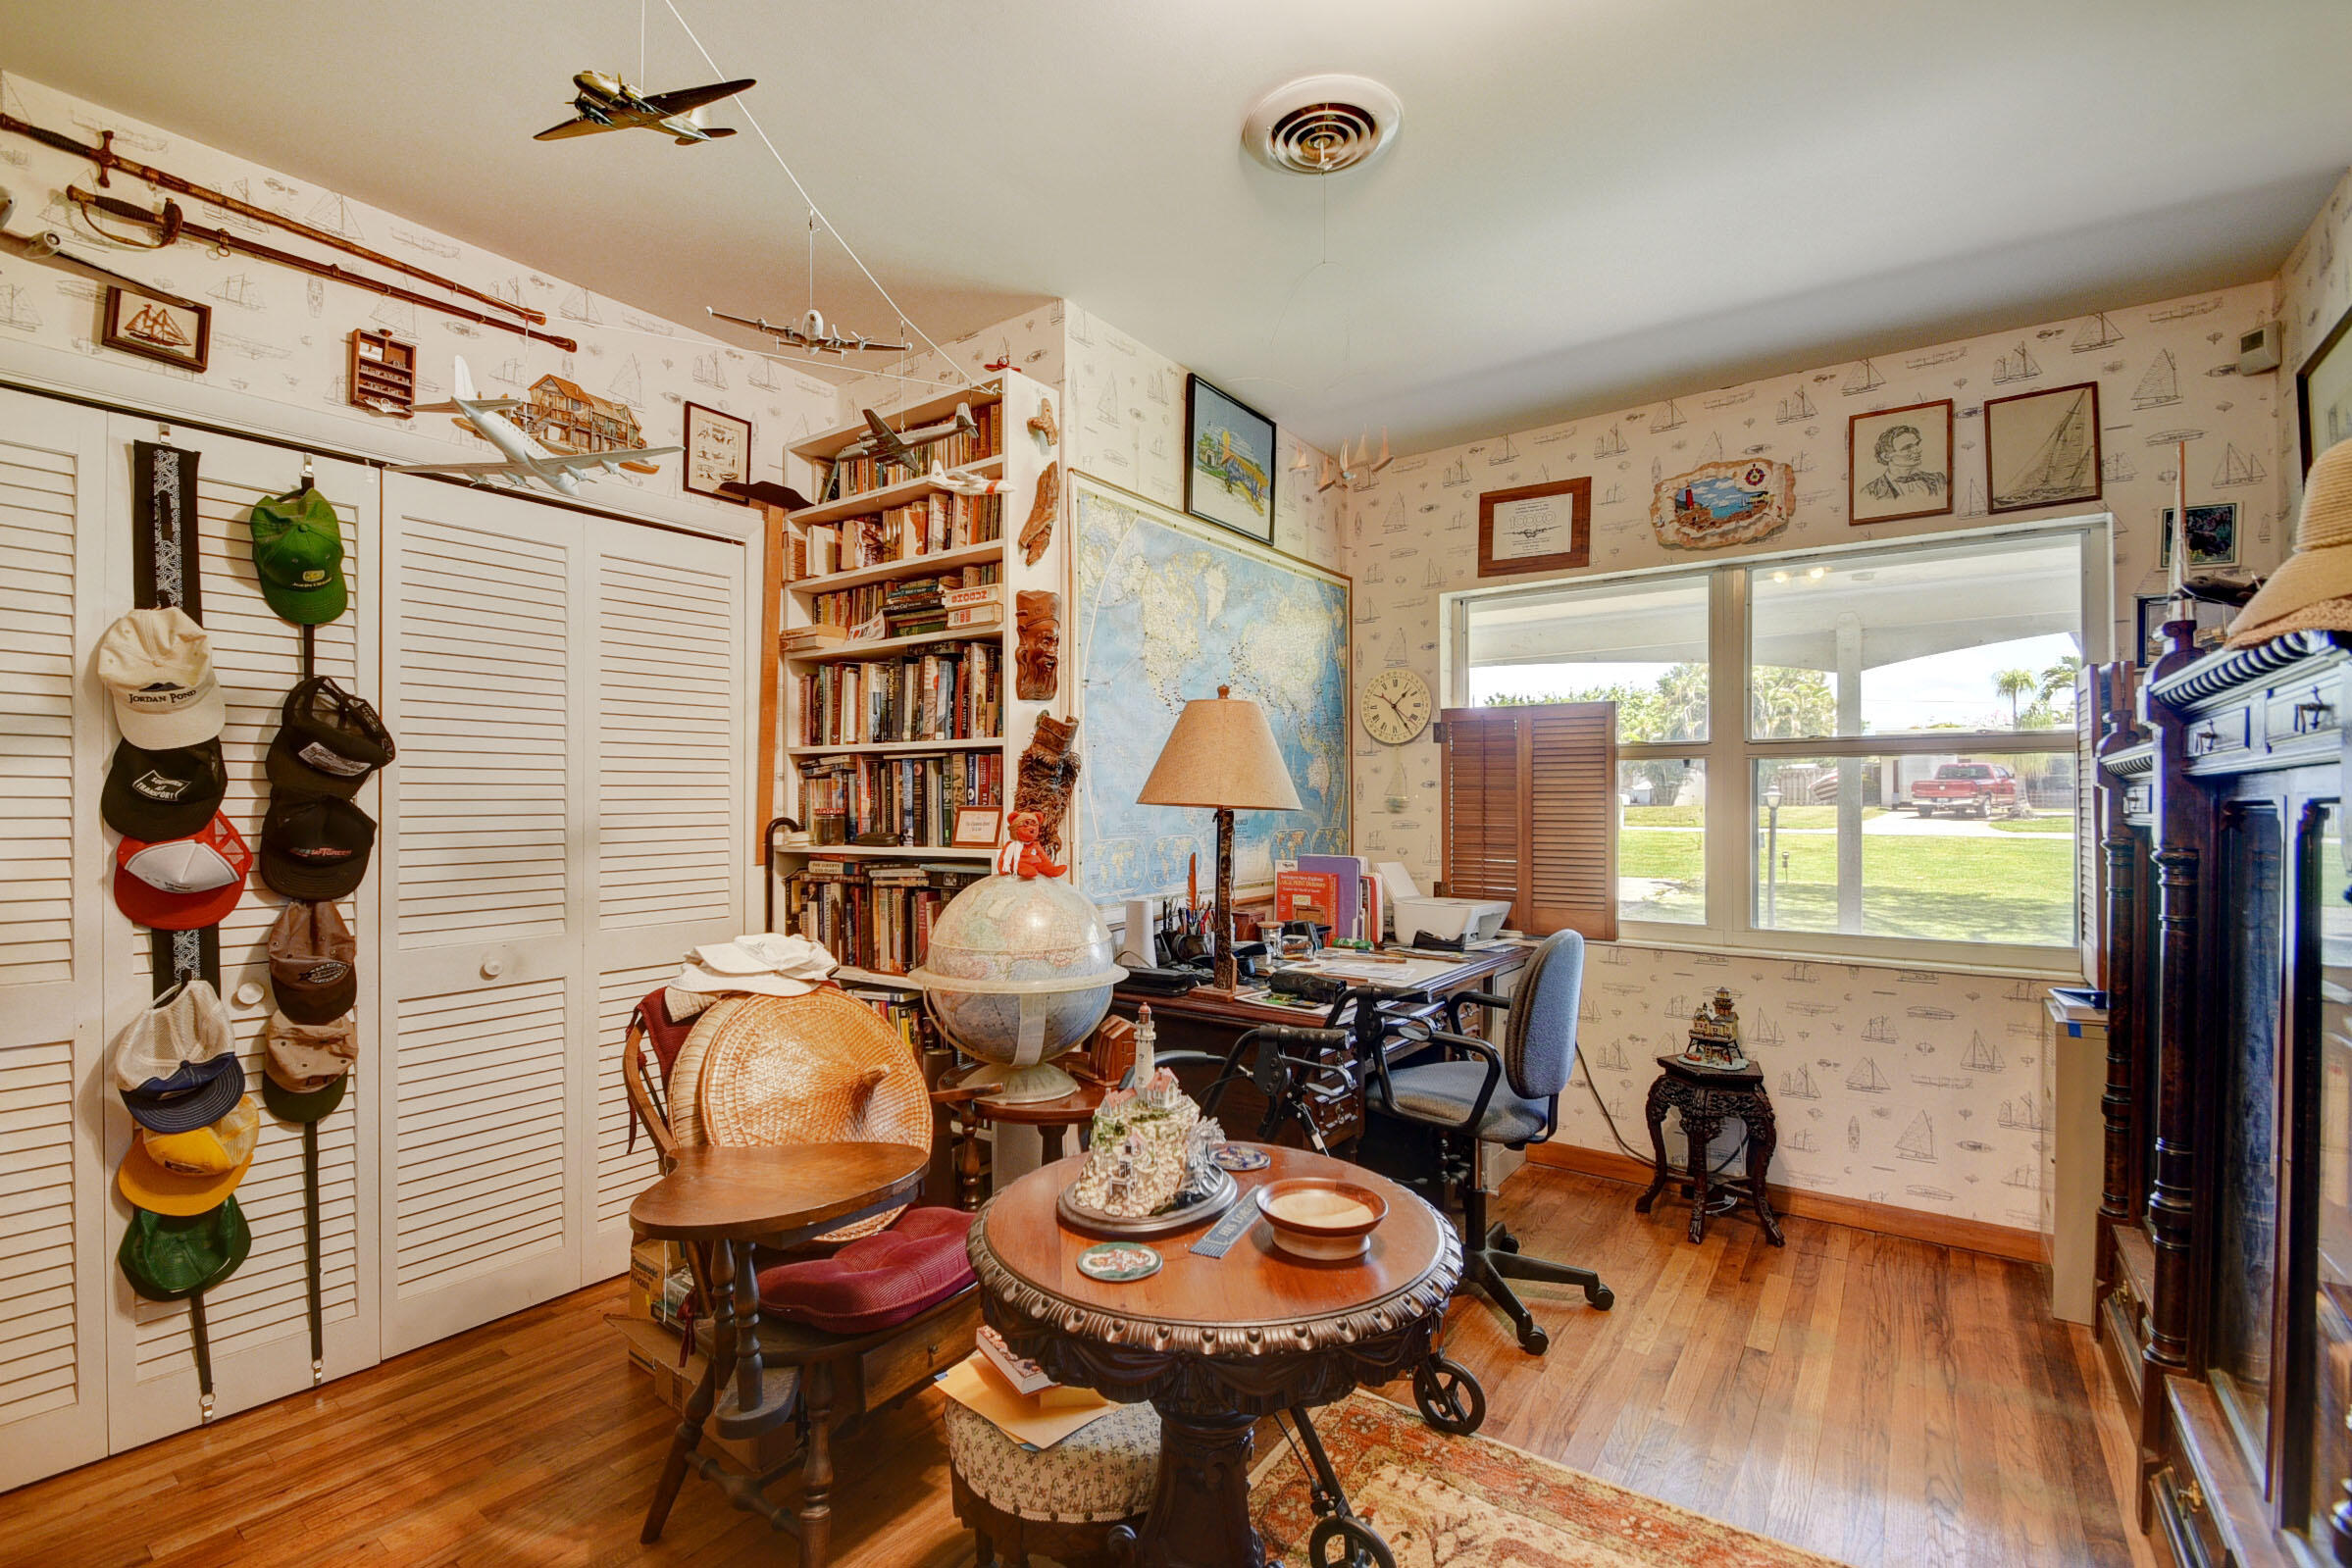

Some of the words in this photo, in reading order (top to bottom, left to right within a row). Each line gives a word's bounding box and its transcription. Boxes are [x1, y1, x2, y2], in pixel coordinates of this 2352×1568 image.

[128, 693, 167, 704] JORDAN
[170, 689, 197, 703] POND
[135, 782, 174, 799] TRANSPORT
